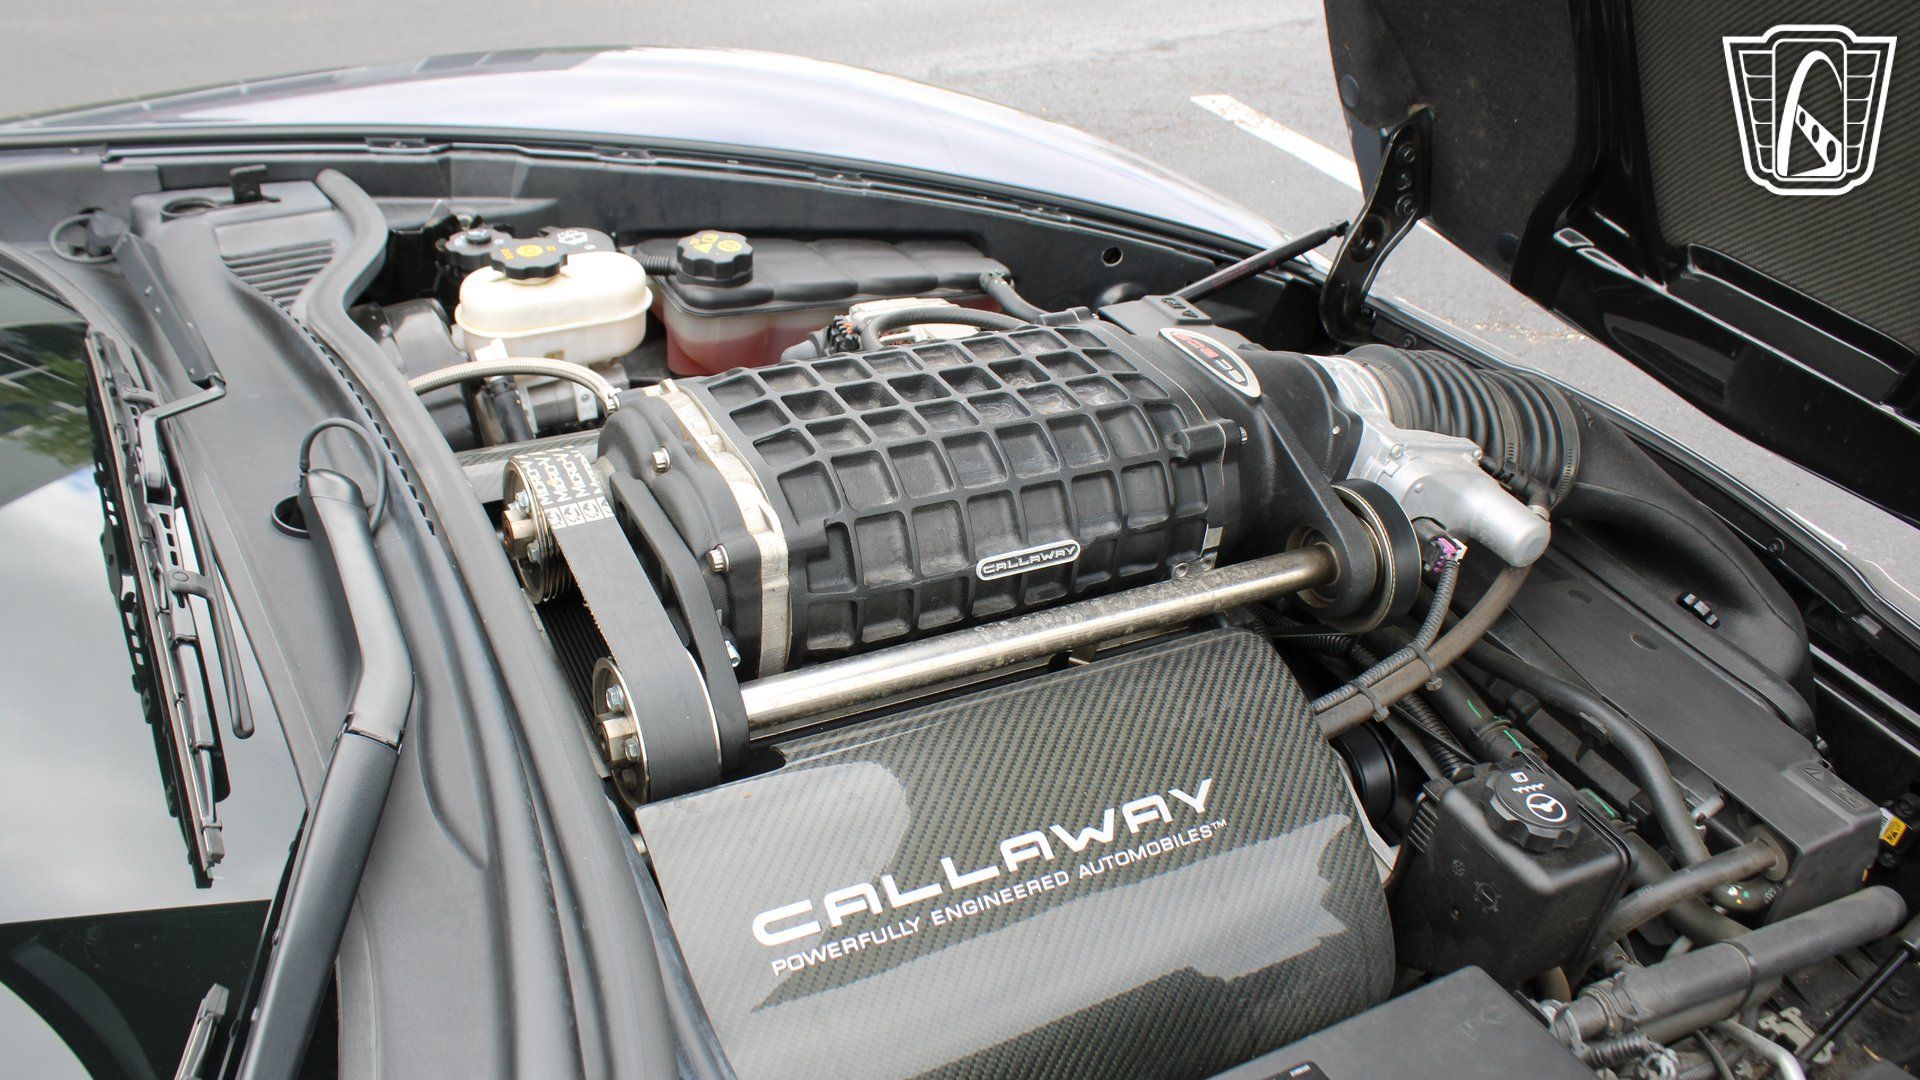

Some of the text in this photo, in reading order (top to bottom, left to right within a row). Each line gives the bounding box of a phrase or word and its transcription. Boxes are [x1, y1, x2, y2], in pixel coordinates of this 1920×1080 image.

[982, 546, 1076, 574] CALLAWAY
[752, 777, 1213, 946] CALLAWAY
[771, 916, 920, 977] POWERFULLY
[930, 870, 1069, 926] ENGINEERED
